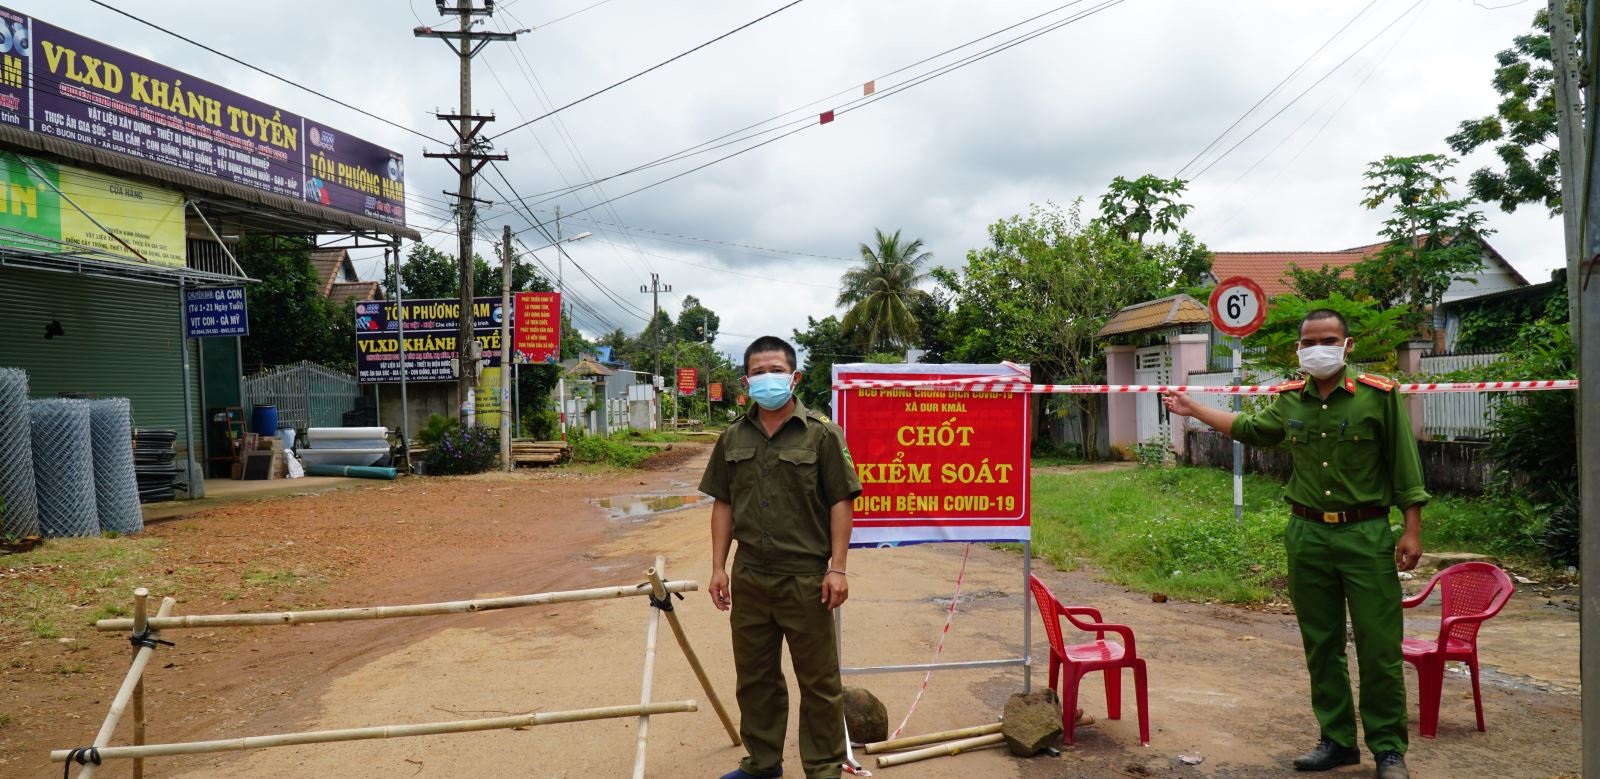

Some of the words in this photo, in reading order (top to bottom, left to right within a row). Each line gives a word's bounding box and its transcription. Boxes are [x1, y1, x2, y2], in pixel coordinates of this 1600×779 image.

[41, 40, 124, 94] VLXD
[130, 72, 222, 127] KHÁNH
[44, 110, 64, 126] THỰC
[66, 114, 76, 130] ĂN
[78, 120, 90, 133] GIA
[112, 130, 124, 142] GIA
[88, 106, 102, 122] VẬT
[102, 111, 118, 126] LIỆU
[119, 116, 132, 130] XÂY
[310, 150, 334, 182] TÔN
[338, 162, 380, 196] PHƯƠNG
[382, 177, 403, 202] NAM
[215, 289, 225, 300] GÀ
[227, 290, 242, 300] CON
[214, 303, 228, 312] Ngày
[413, 302, 459, 320] PHƯƠNG
[473, 303, 490, 317] AM
[191, 318, 200, 328] VỊT
[202, 317, 215, 326] CON
[220, 314, 229, 325] GÀ
[358, 339, 399, 352] VLXD
[403, 334, 456, 352] KHÁNH
[920, 403, 938, 412] DUR
[897, 417, 974, 446] CHỐT
[857, 452, 931, 484] KIỂM
[941, 458, 1013, 484] SOÁT
[854, 496, 891, 515] DỊCH
[896, 492, 938, 515] BỆNH
[944, 496, 1014, 511] COVID-19
